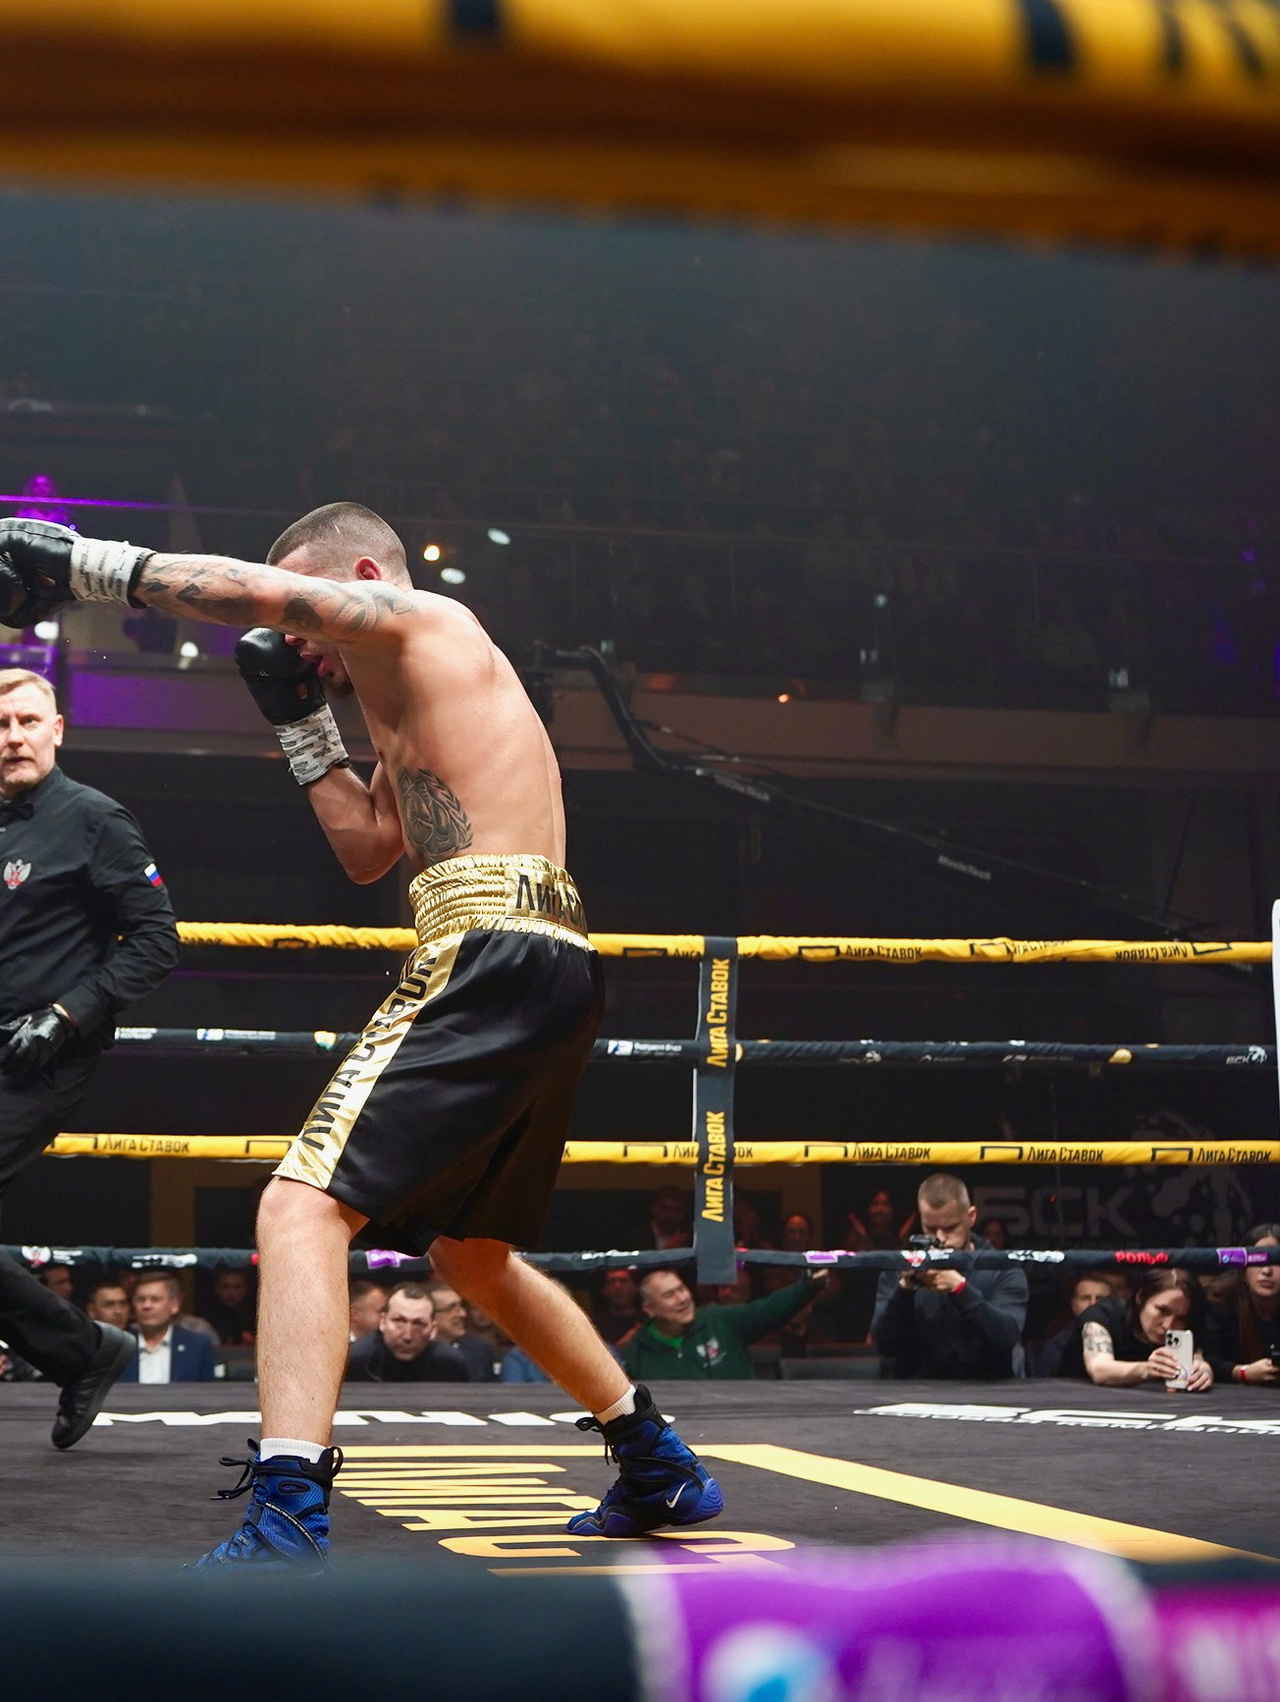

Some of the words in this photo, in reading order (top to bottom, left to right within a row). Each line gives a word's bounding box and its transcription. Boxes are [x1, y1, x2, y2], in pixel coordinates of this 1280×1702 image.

[706, 958, 730, 1024] СТАВОК
[706, 1025, 729, 1068] ЛИГА
[673, 1144, 699, 1158] ЛИГ
[703, 1111, 726, 1175] СТАВОК
[852, 1145, 883, 1159] ЛИГА
[885, 1145, 931, 1160] СТАВОК
[1027, 1146, 1057, 1161] ЛИГА
[1059, 1146, 1104, 1162] СТАВОК
[1196, 1147, 1225, 1162] ЛИГА
[1226, 1148, 1272, 1163] СТАВОК
[701, 1177, 725, 1222] ЛИГА
